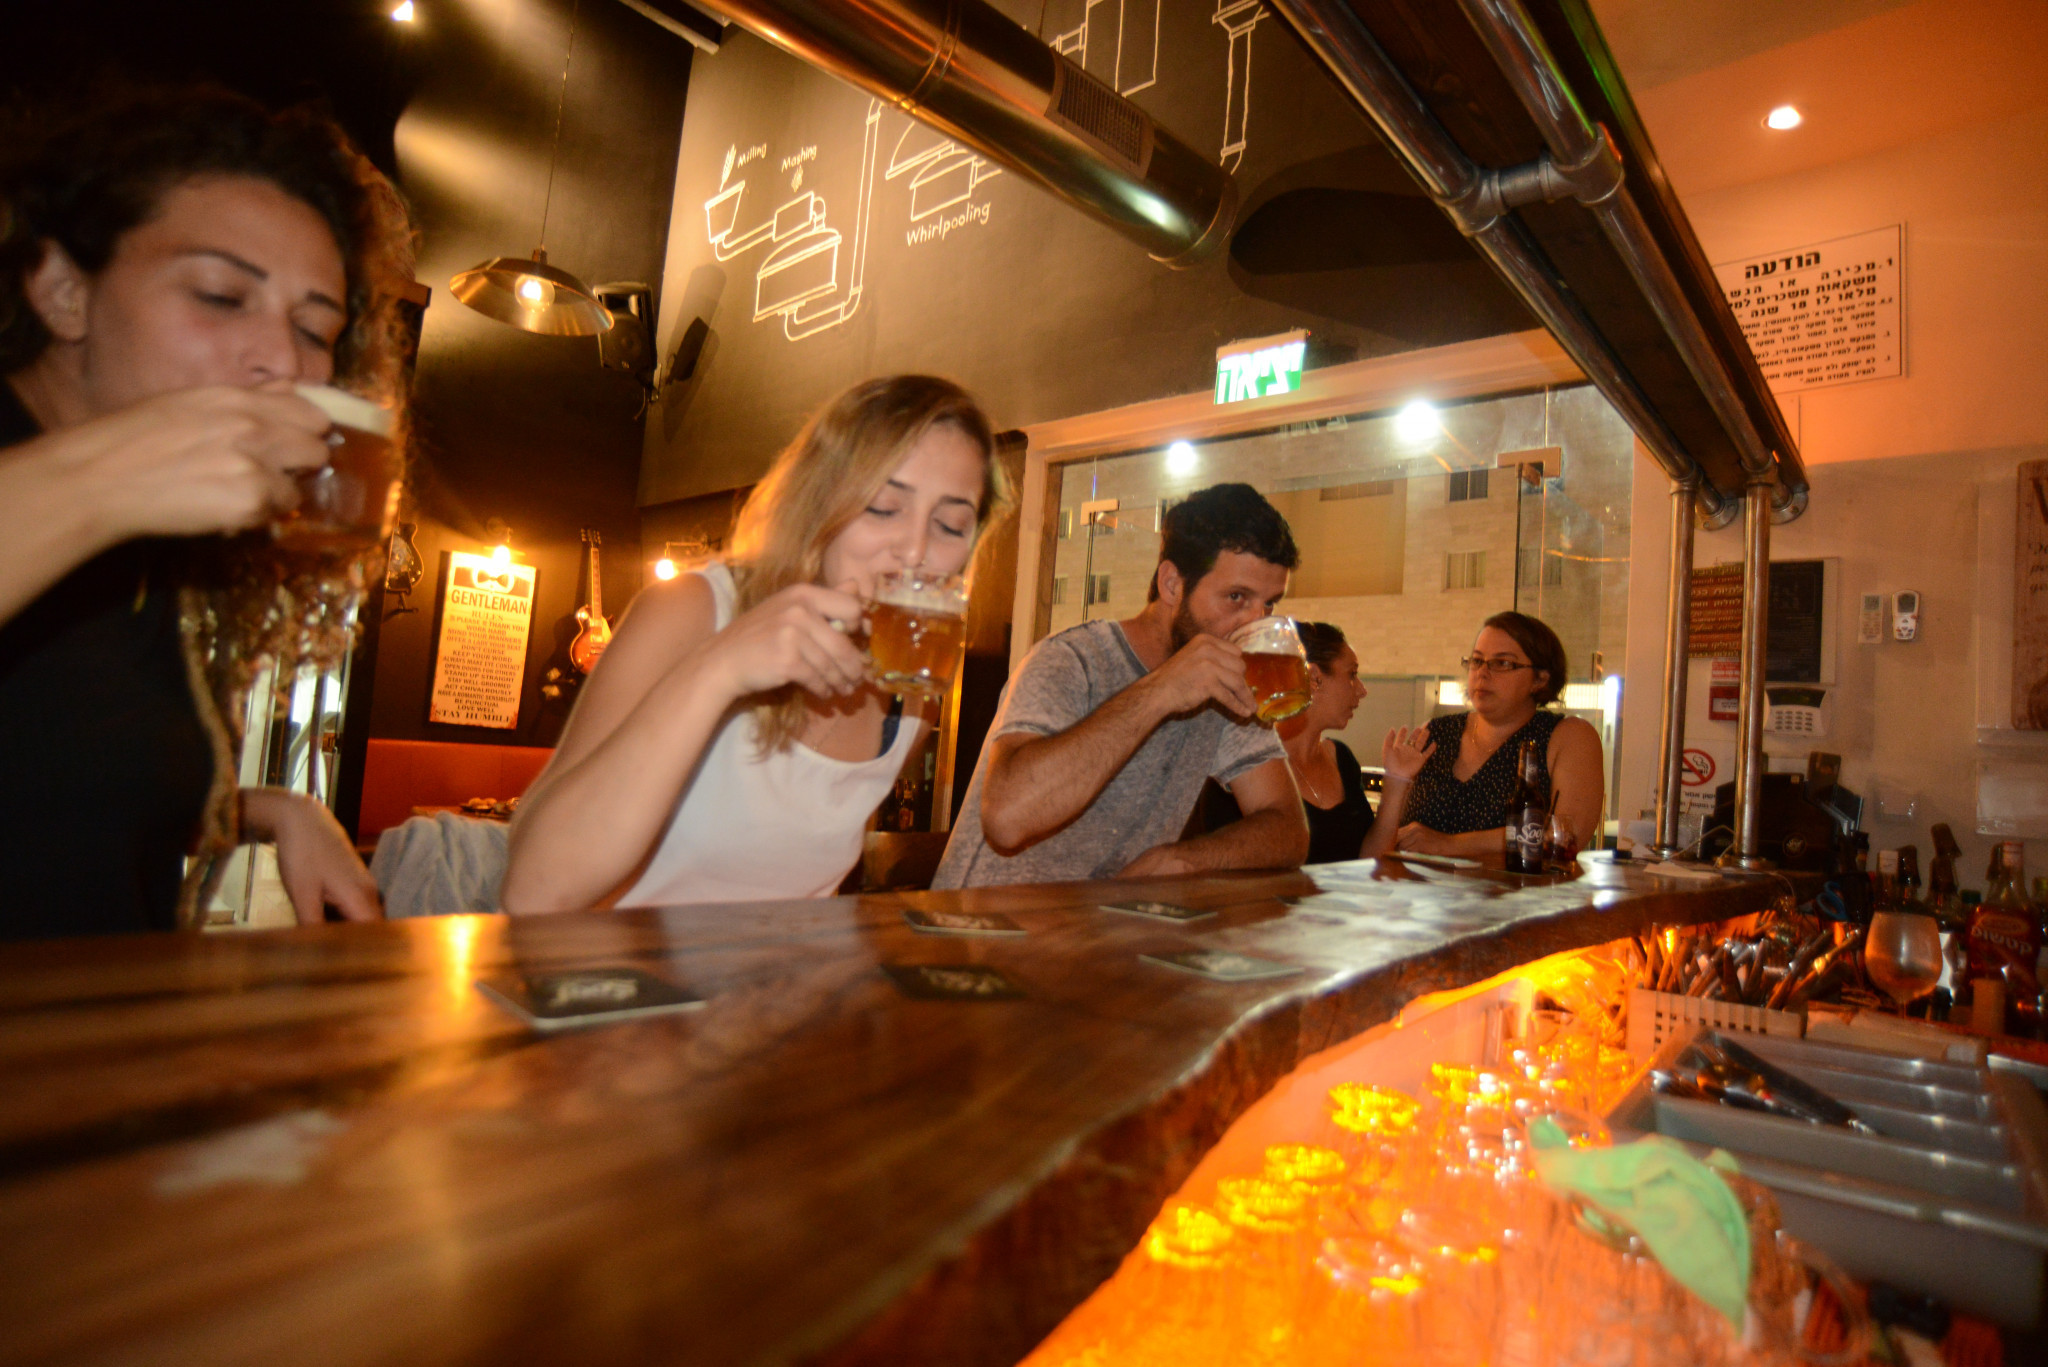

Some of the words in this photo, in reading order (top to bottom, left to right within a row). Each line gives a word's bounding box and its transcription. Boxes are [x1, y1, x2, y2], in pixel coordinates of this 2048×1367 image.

[738, 143, 767, 168] Milling
[781, 144, 817, 174] Mashing
[906, 202, 991, 246] Whirlpooling
[1745, 251, 1820, 280] הודעה
[1821, 262, 1875, 281] מכירה
[1780, 279, 1796, 289] או
[1816, 274, 1876, 294] משקאות
[1725, 285, 1762, 299] הגש
[1757, 288, 1809, 305] משכרים
[1838, 286, 1876, 302] מלאו
[1791, 300, 1807, 310] 18
[1816, 295, 1830, 306] לו
[1750, 306, 1779, 318] שנה
[451, 589, 529, 615] GENTLEMAN
[472, 610, 504, 621] RULES
[457, 616, 479, 625] PLEASE
[490, 621, 511, 631] THANK
[513, 624, 526, 633] YOU
[466, 625, 486, 633] WORK
[488, 628, 507, 636] HARD
[448, 628, 467, 636] MIND
[469, 632, 487, 640] YOUR
[489, 634, 522, 645] MANNERS
[472, 652, 490, 660] YOUR
[491, 655, 513, 663] WORD
[483, 647, 505, 655] CURSE
[443, 656, 465, 664] ALWAYS
[496, 663, 520, 671] CONTACT
[444, 670, 467, 678] STAND
[481, 674, 514, 683] STRAIGHT
[457, 691, 485, 700] ROMANTIC
[485, 695, 515, 703] SENSIBILITY
[460, 685, 512, 695] CHIVALROUSLY
[465, 700, 499, 708] PUNCTUAL
[435, 709, 460, 718] STAY
[465, 712, 511, 723] HUMBLE
